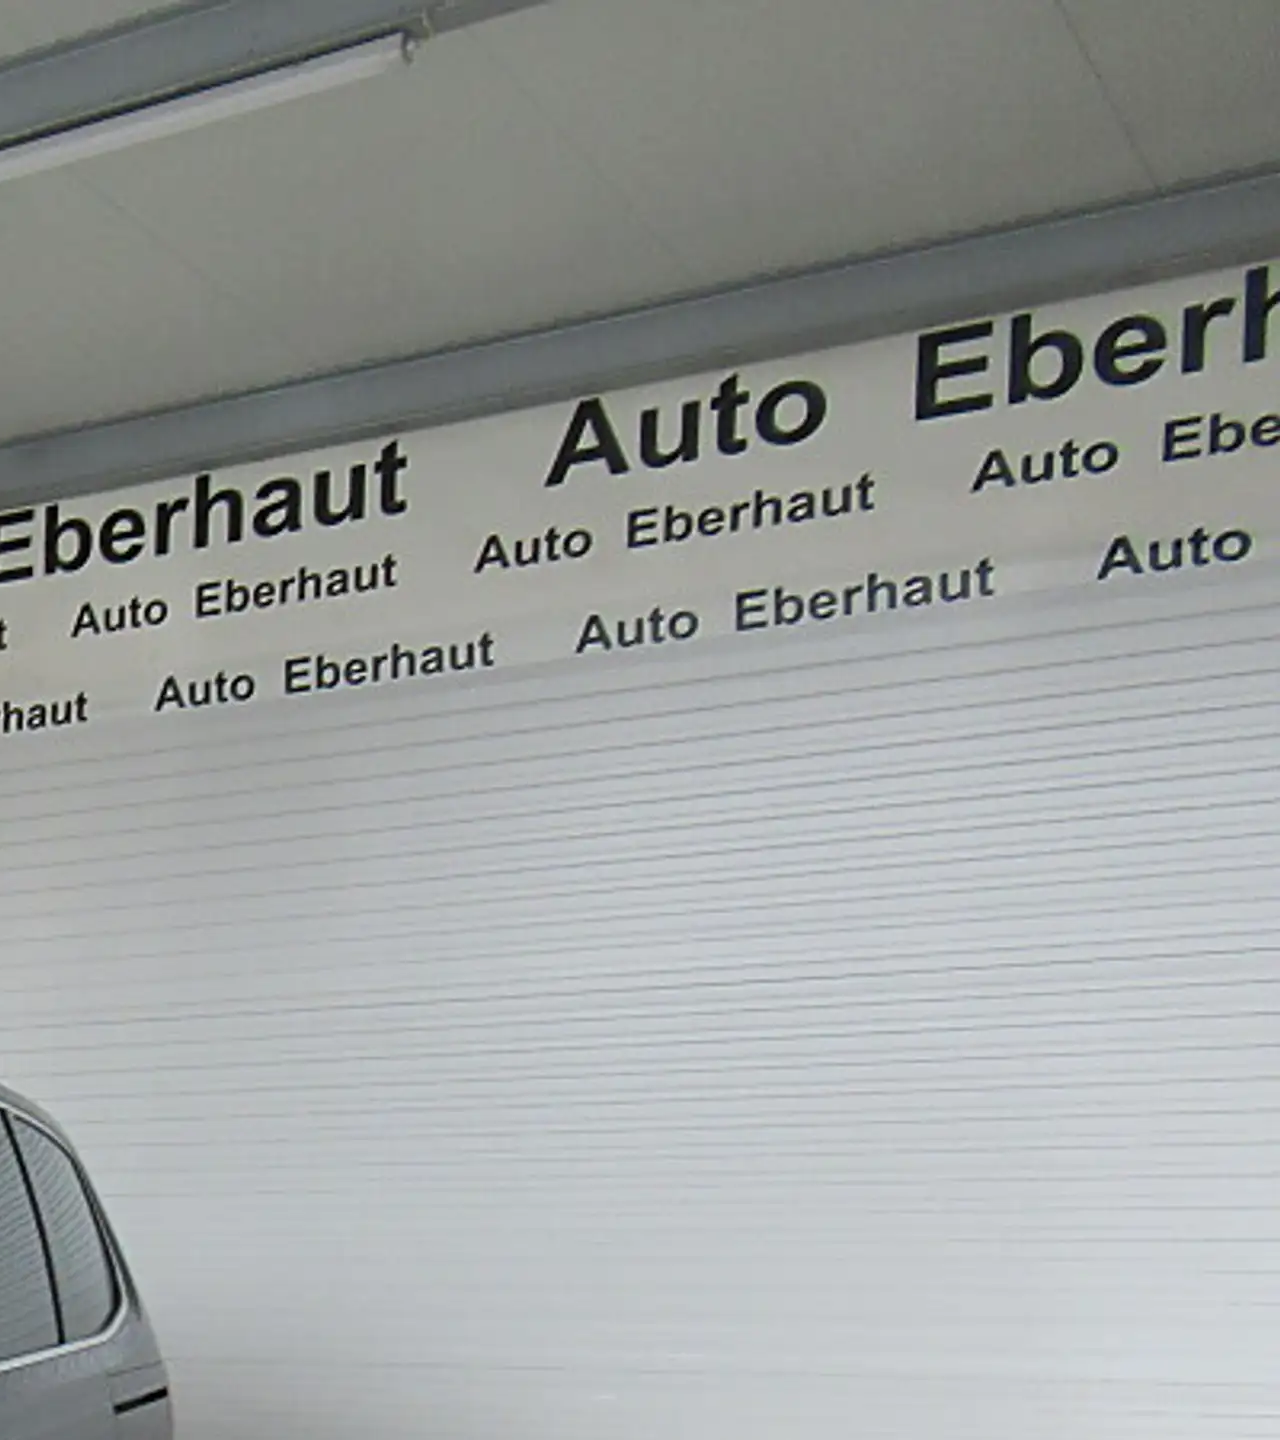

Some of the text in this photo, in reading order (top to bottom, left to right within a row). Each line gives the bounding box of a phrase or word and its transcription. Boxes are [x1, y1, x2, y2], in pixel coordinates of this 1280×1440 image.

[543, 373, 827, 488] Auto
[971, 438, 1119, 493] Auto
[473, 473, 875, 574] Auto Eberhaut
[1097, 527, 1252, 581] Auto
[70, 553, 397, 638] Auto Eberhaut
[575, 557, 994, 654] Auto Eberhaut
[154, 632, 494, 712] Auto Eberhaut
